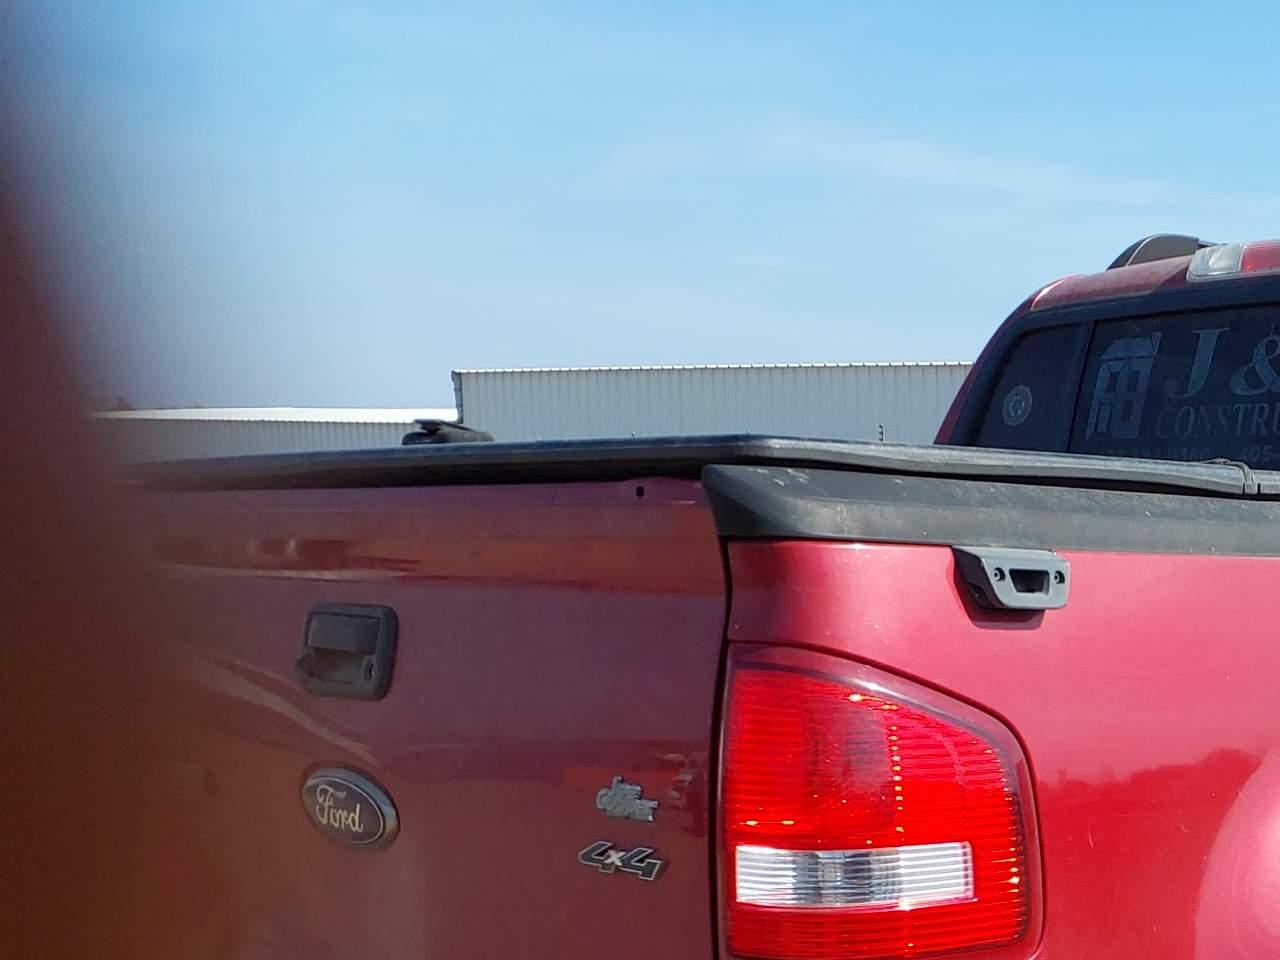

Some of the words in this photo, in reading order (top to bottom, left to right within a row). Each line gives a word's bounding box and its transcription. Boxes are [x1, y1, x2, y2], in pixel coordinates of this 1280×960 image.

[1163, 327, 1231, 399] J
[315, 784, 364, 834] Ford
[578, 841, 663, 881] 4x4
